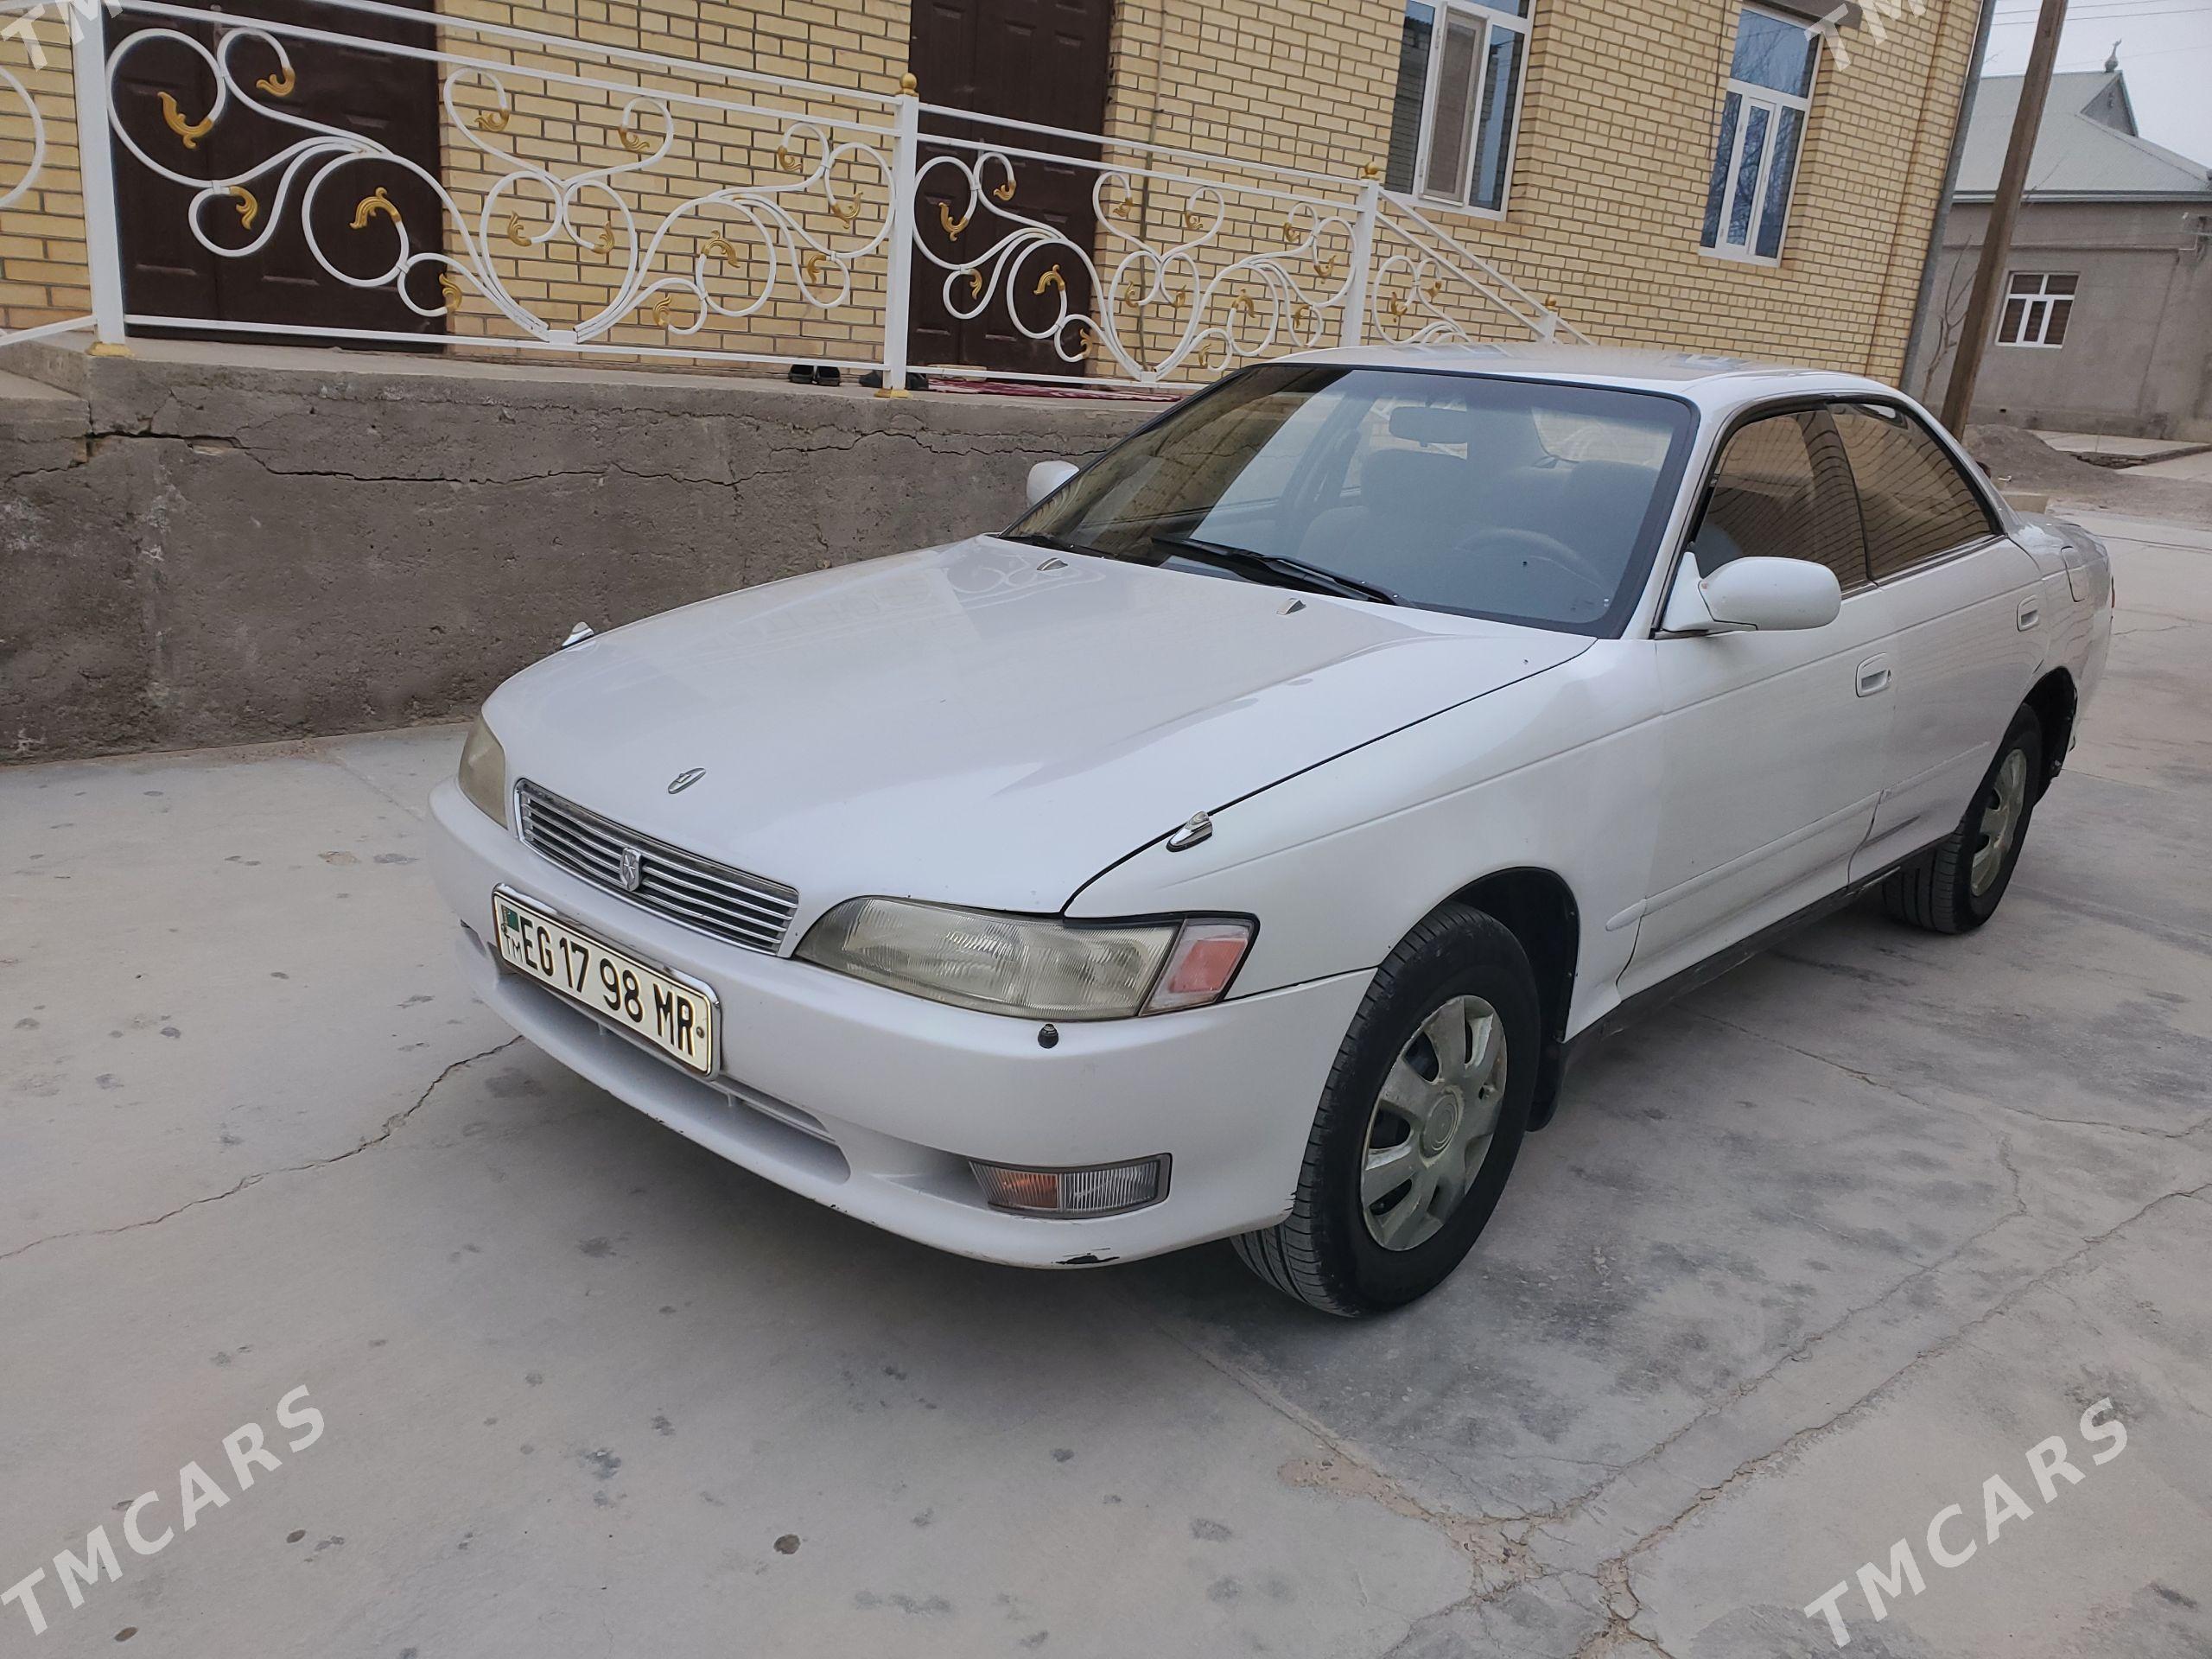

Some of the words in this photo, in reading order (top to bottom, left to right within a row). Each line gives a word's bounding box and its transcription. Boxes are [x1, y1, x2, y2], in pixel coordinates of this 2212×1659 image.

[504, 933, 524, 963] TM
[520, 916, 555, 976] EG
[560, 938, 589, 993] 17
[600, 957, 644, 1023] 98
[653, 983, 695, 1057] MR
